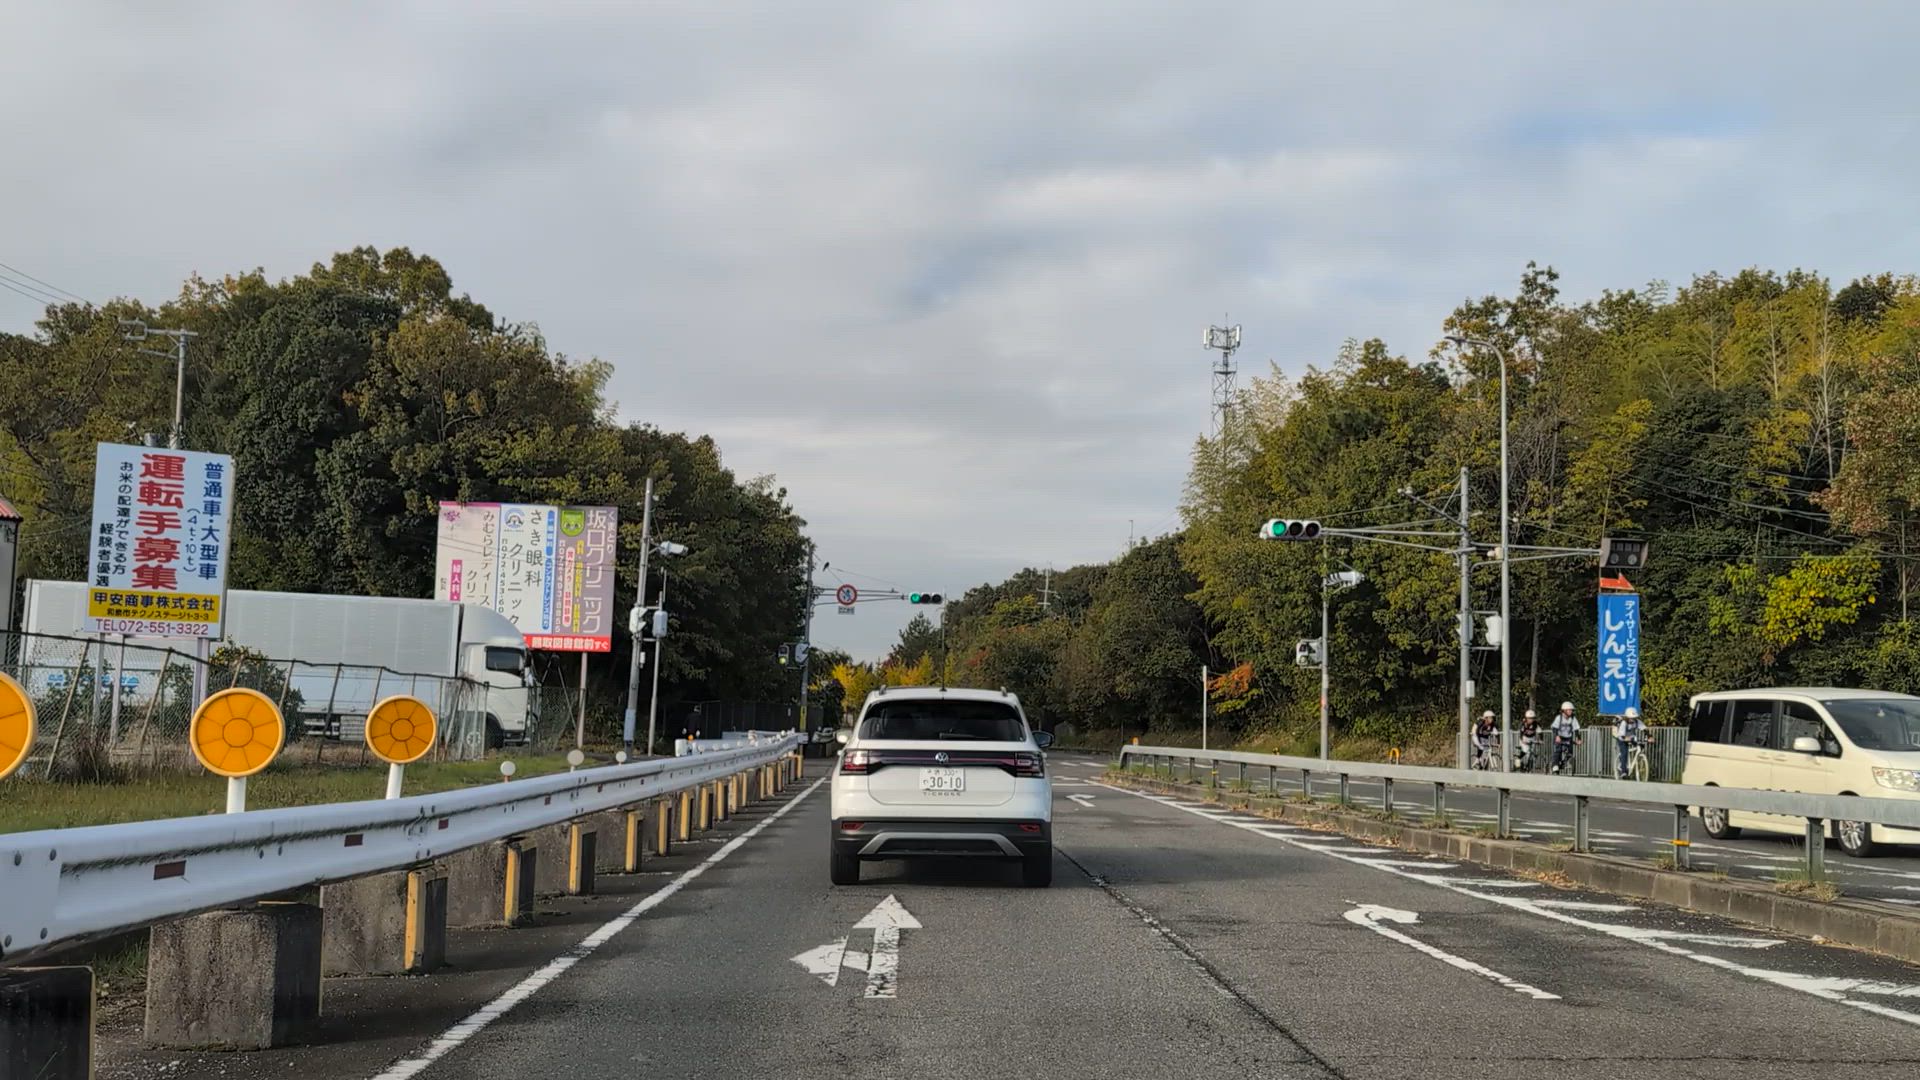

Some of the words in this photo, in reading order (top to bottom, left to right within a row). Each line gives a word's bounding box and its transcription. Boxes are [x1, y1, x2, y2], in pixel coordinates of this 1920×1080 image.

[96, 523, 114, 587] 経験者優遇
[132, 453, 186, 590] 運転手募集
[198, 462, 224, 580] 普通車・大型車
[480, 511, 495, 606] みむらレディース
[525, 509, 543, 587] さき眼科
[94, 591, 215, 611] 甲安商事株式会社
[507, 543, 523, 625] クリニック
[583, 509, 607, 633] 坂口クリニック
[1603, 609, 1627, 702] しんえい
[1625, 600, 1638, 697] デイサービスセンター
[929, 776, 962, 789] 30-10
